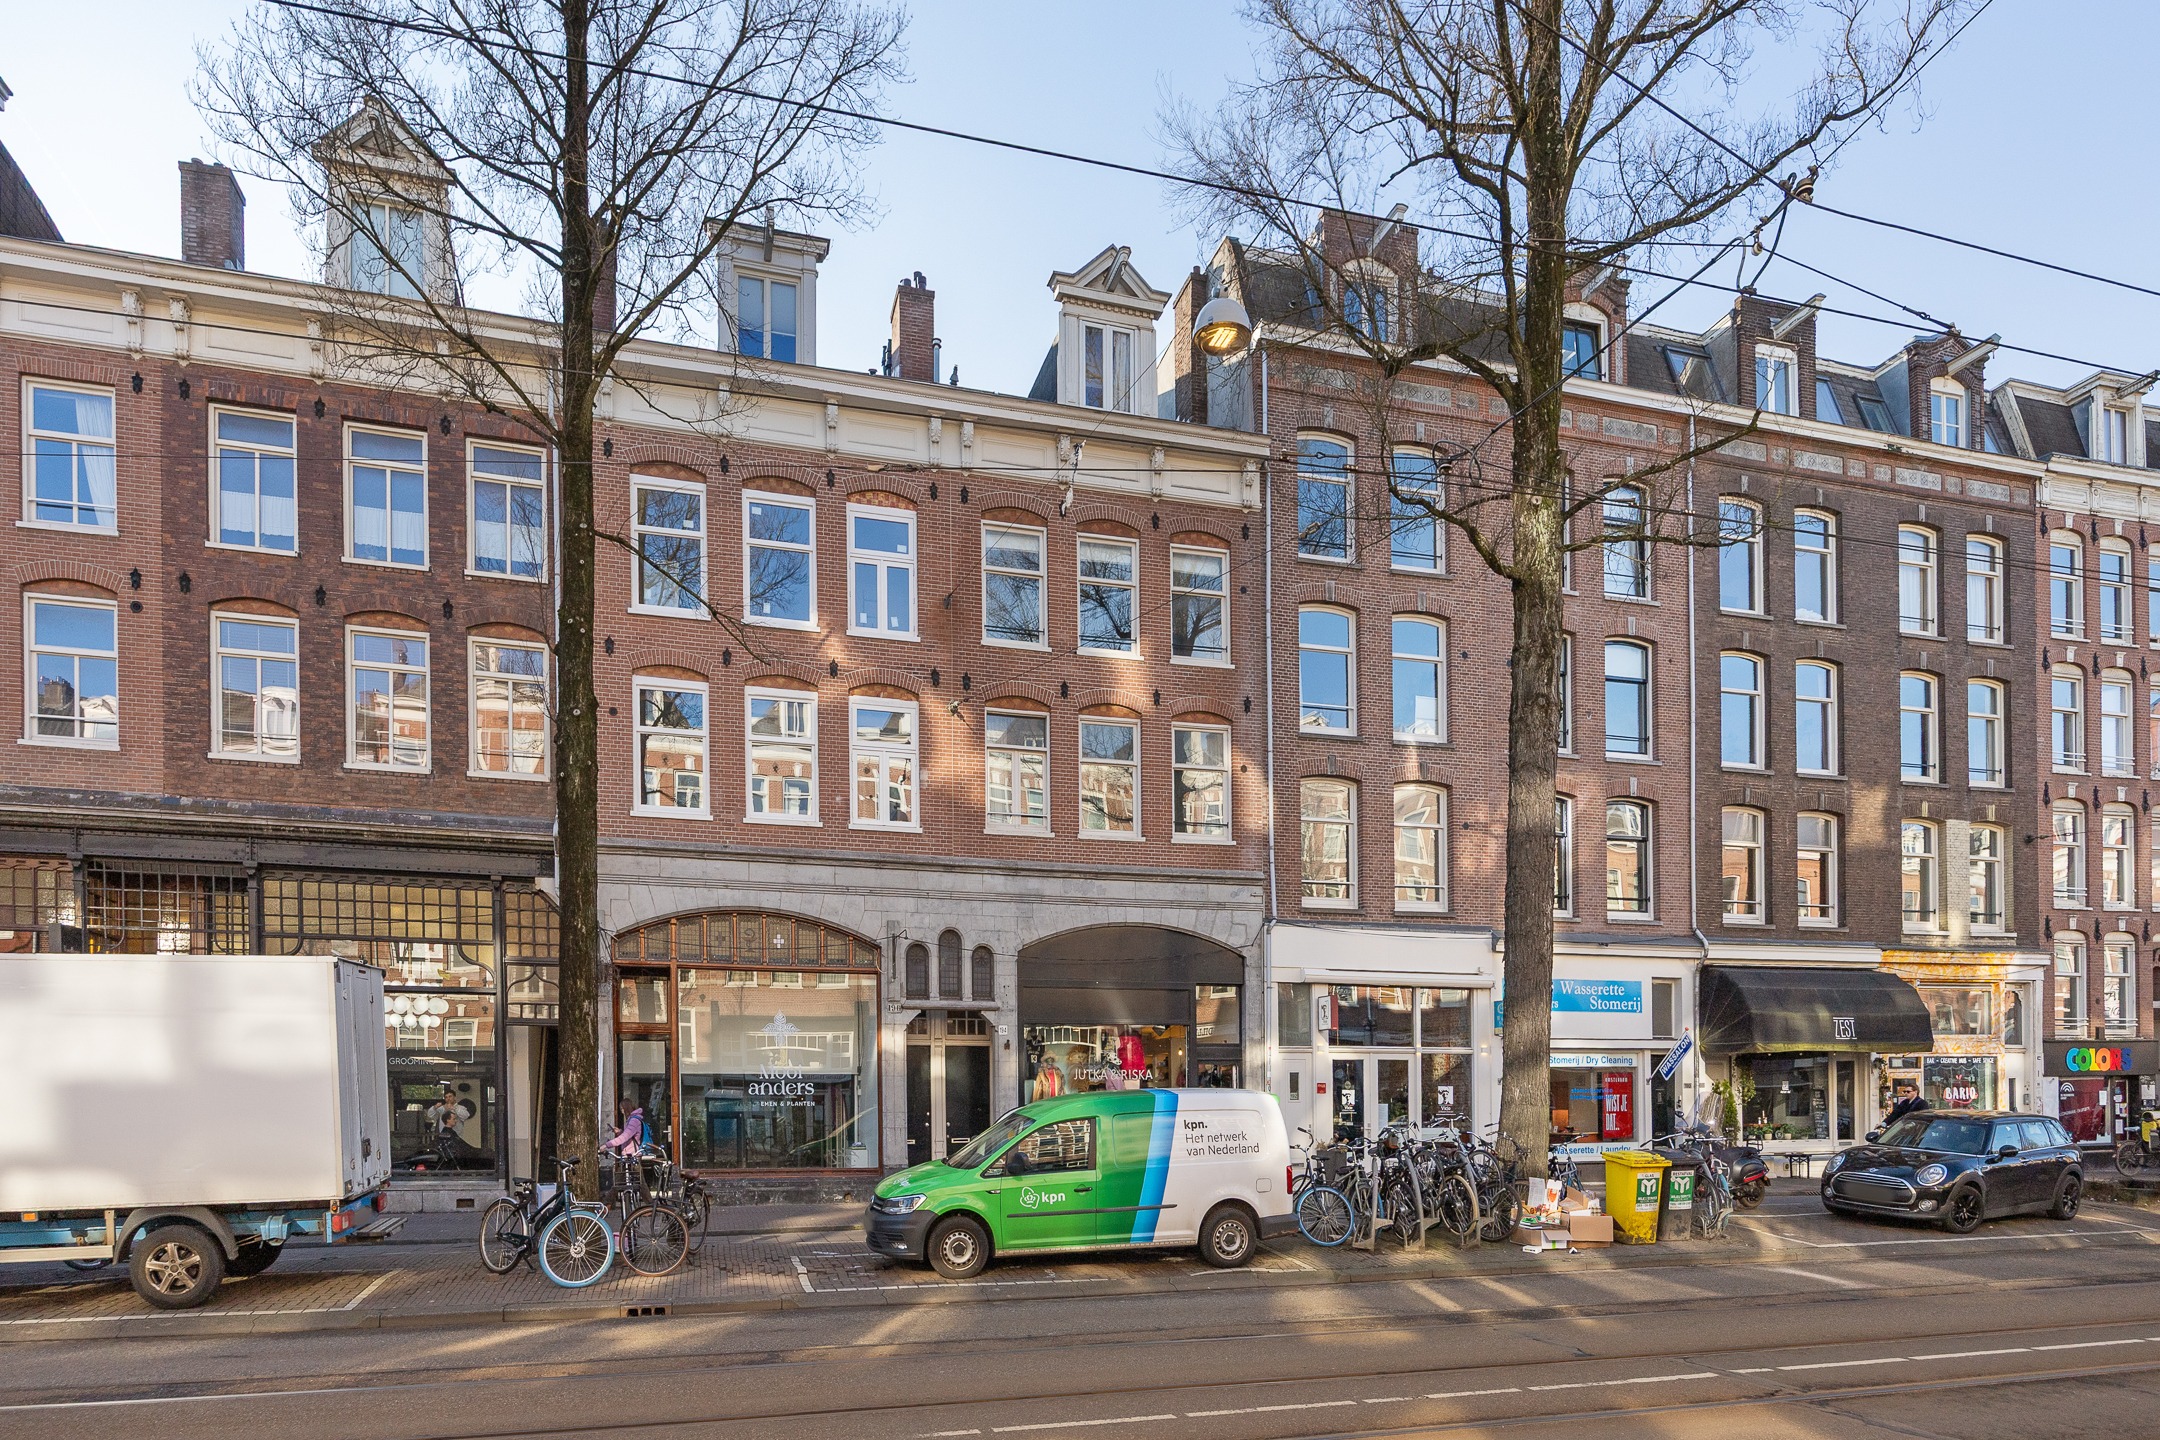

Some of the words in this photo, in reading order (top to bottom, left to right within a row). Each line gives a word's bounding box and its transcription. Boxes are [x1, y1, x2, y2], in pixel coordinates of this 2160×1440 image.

[1560, 981, 1625, 996] Wasserette
[1589, 995, 1641, 1012] Stomerij
[1833, 1019, 1856, 1038] ZEST
[1549, 1055, 1580, 1066] Stomerij
[1586, 1056, 1599, 1066] Dry
[1601, 1055, 1633, 1066] Cleaning
[1661, 1036, 1690, 1074] WASSALON
[2066, 1047, 2132, 1072] COLORS
[1074, 1069, 1108, 1080] JUTKA
[1121, 1069, 1153, 1080] RISKA
[748, 1080, 815, 1096] anders
[1605, 1094, 1620, 1112] WIST
[1620, 1094, 1628, 1112] JE
[1183, 1119, 1208, 1132] kpn.
[1185, 1133, 1204, 1143] Het
[1207, 1131, 1248, 1143] netwerk
[1186, 1147, 1205, 1156] van
[1208, 1142, 1260, 1156] Nederland
[1041, 1191, 1066, 1205] kpn
